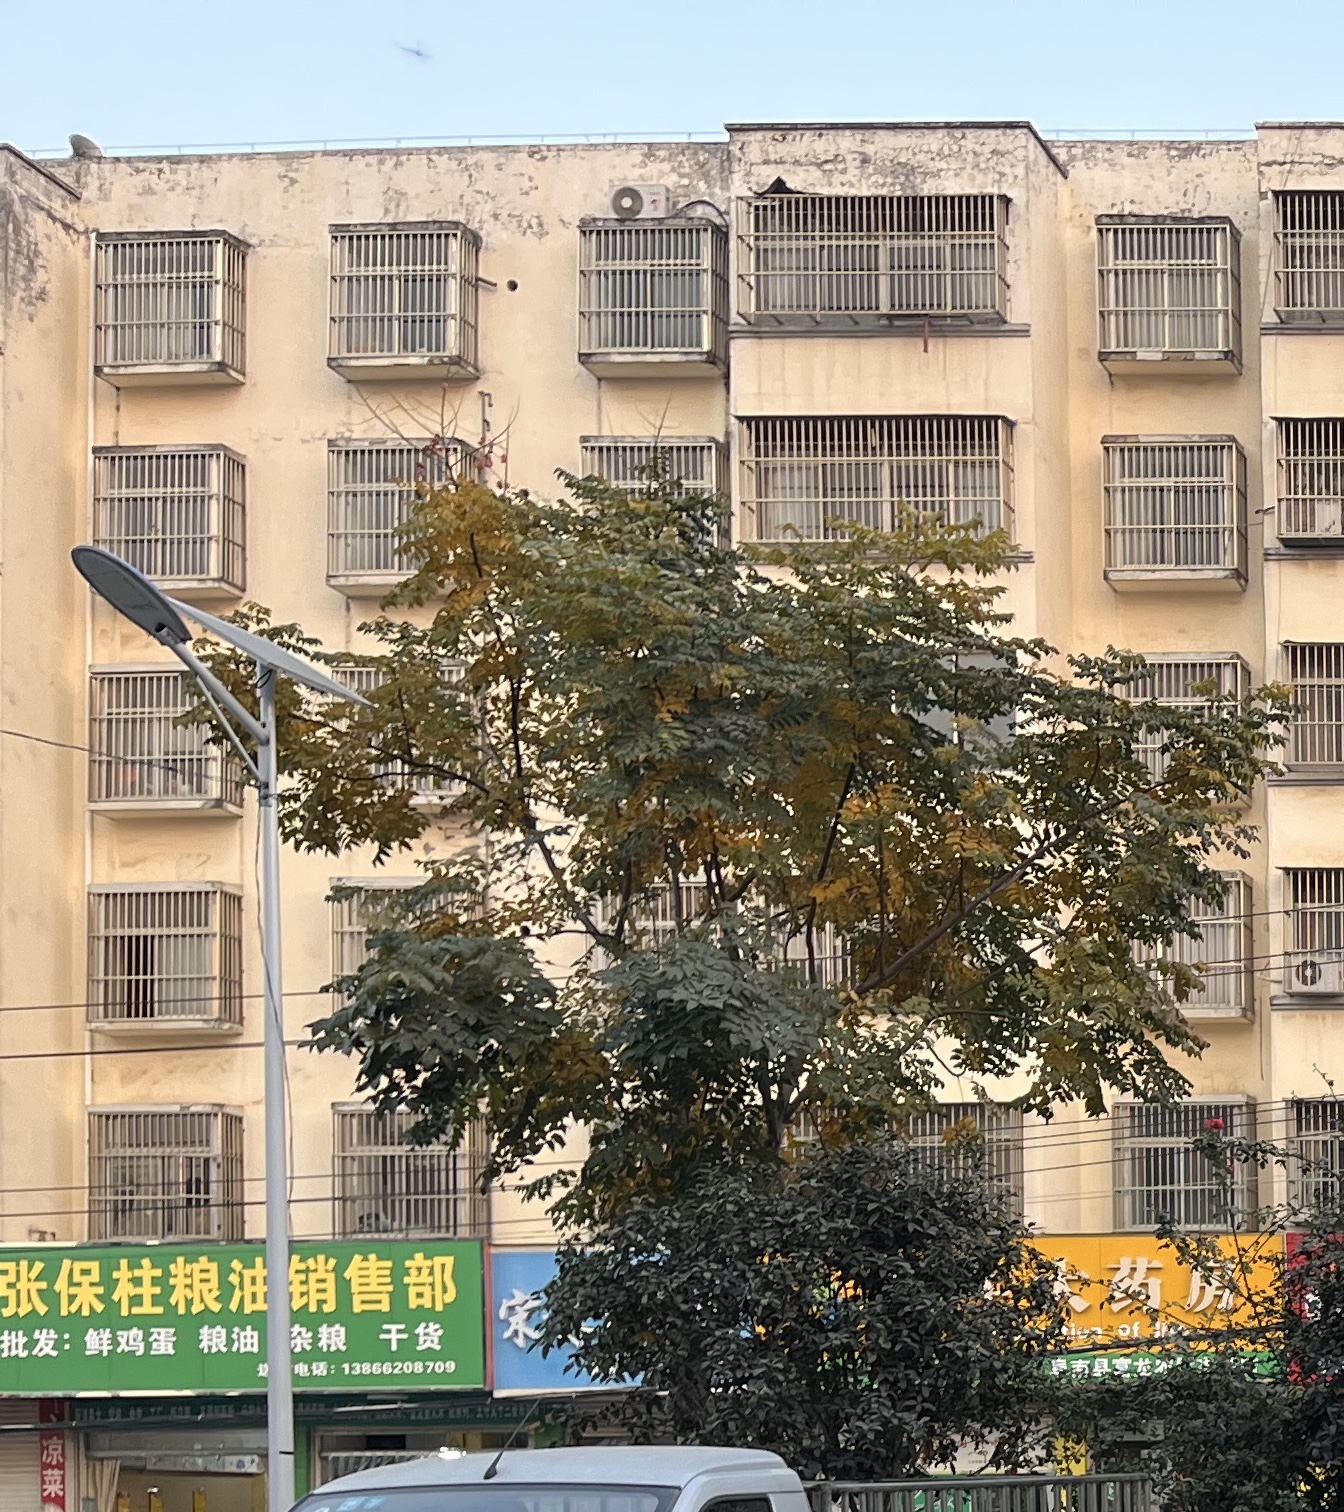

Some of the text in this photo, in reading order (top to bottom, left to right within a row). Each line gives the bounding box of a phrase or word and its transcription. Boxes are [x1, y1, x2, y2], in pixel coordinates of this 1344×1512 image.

[0, 1252, 457, 1318] 张保柱粮油销售部
[198, 1325, 260, 1355] 粮油
[379, 1322, 444, 1352] 干货
